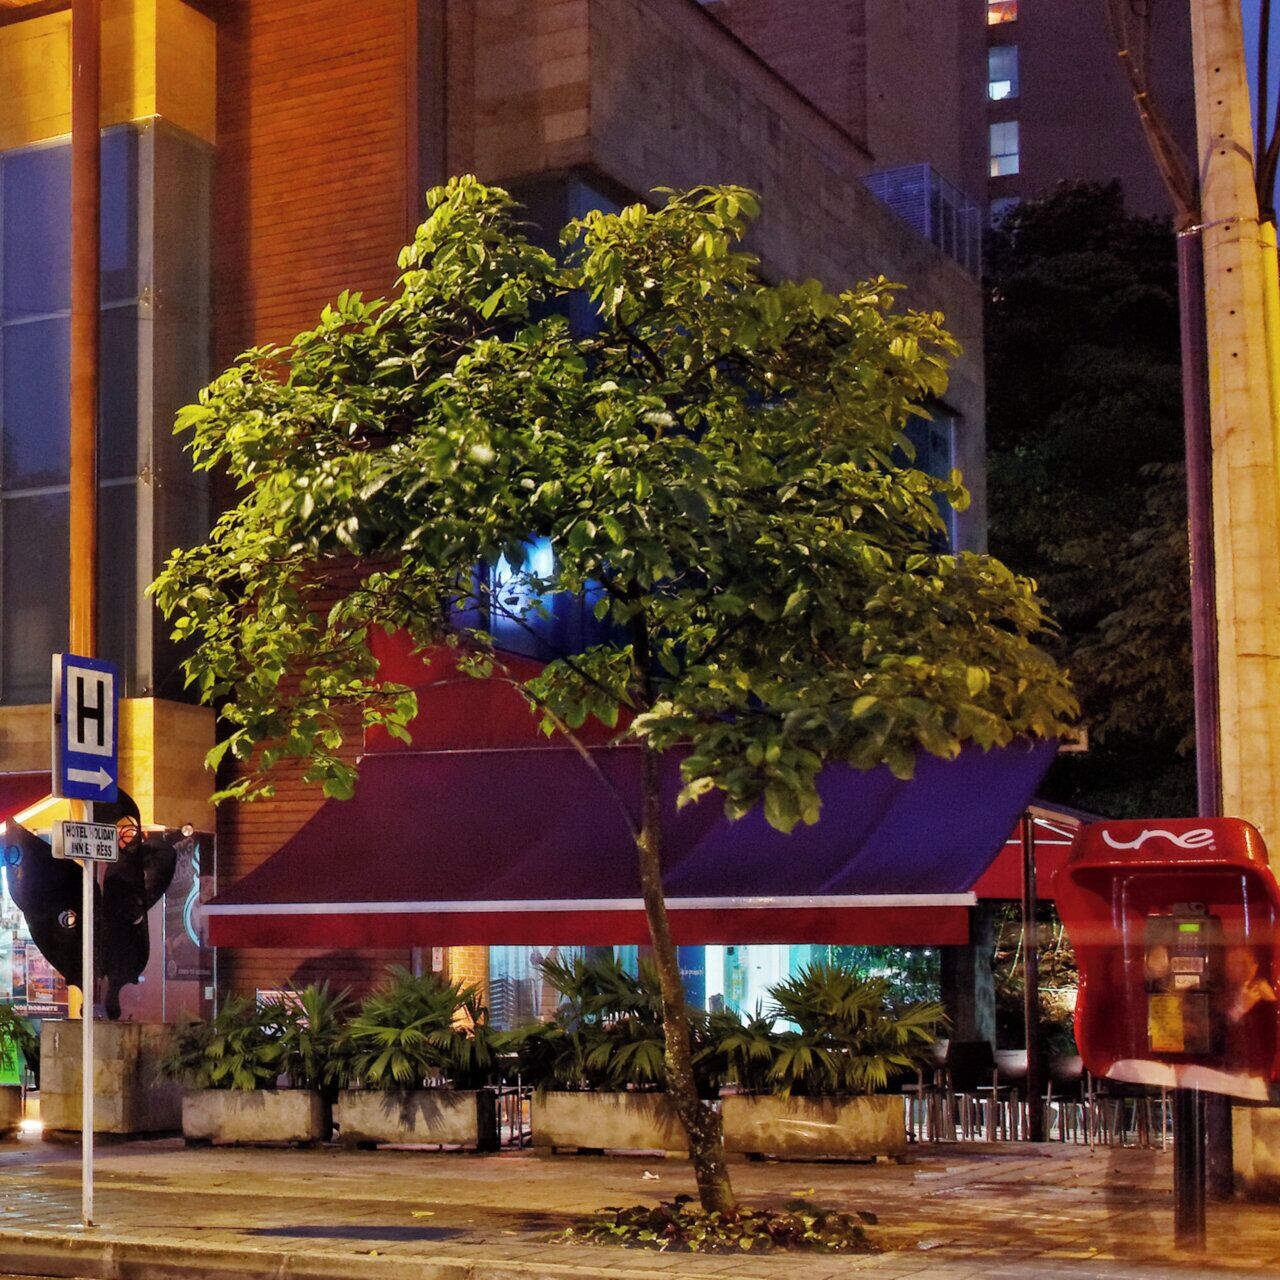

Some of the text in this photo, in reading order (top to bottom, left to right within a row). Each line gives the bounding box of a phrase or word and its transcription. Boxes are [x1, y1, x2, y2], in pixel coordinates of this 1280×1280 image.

[76, 676, 105, 747] H
[65, 824, 115, 841] HOTEL OLIDAY
[1102, 828, 1215, 850] une
[71, 842, 113, 858] INN ERESS
